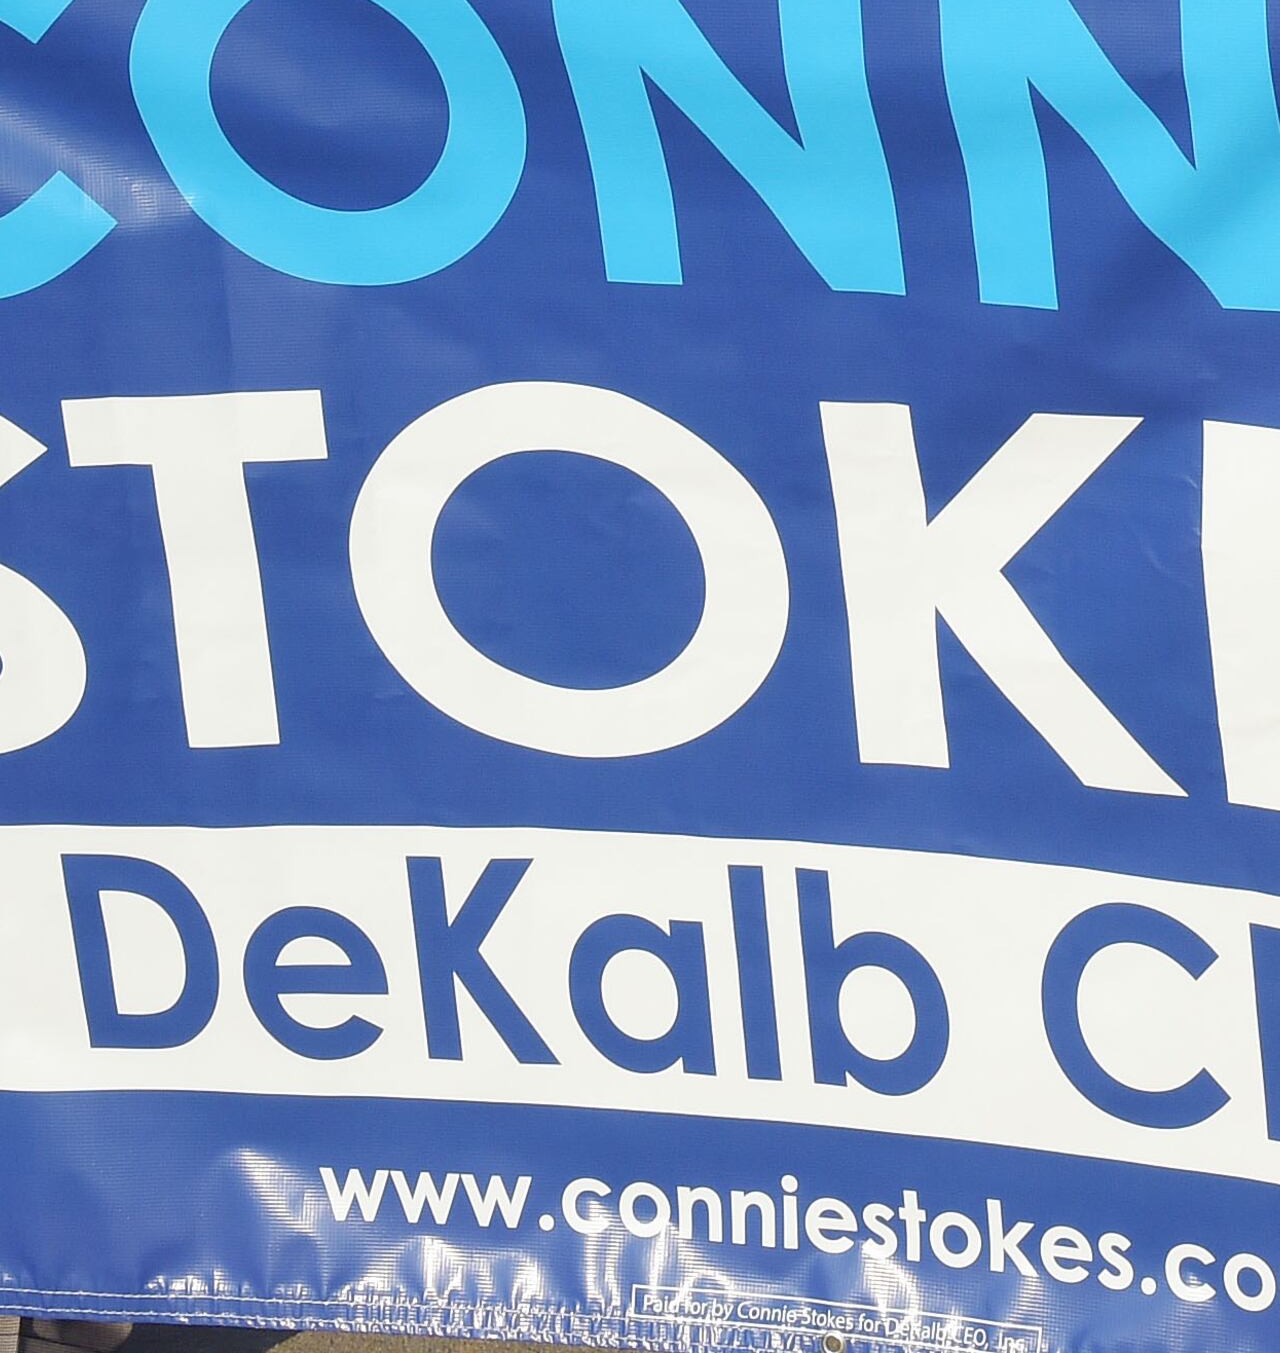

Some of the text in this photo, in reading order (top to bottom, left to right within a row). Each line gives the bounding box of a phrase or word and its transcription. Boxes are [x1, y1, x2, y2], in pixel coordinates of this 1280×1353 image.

[60, 854, 951, 1097] DeKalb
[643, 1293, 681, 1314] Paid
[684, 1299, 709, 1317] for
[712, 1300, 734, 1322] by
[737, 1301, 798, 1323] Connie
[804, 1306, 854, 1331] Stokes
[858, 1313, 881, 1333] for
[885, 1317, 948, 1342] DeKalb
